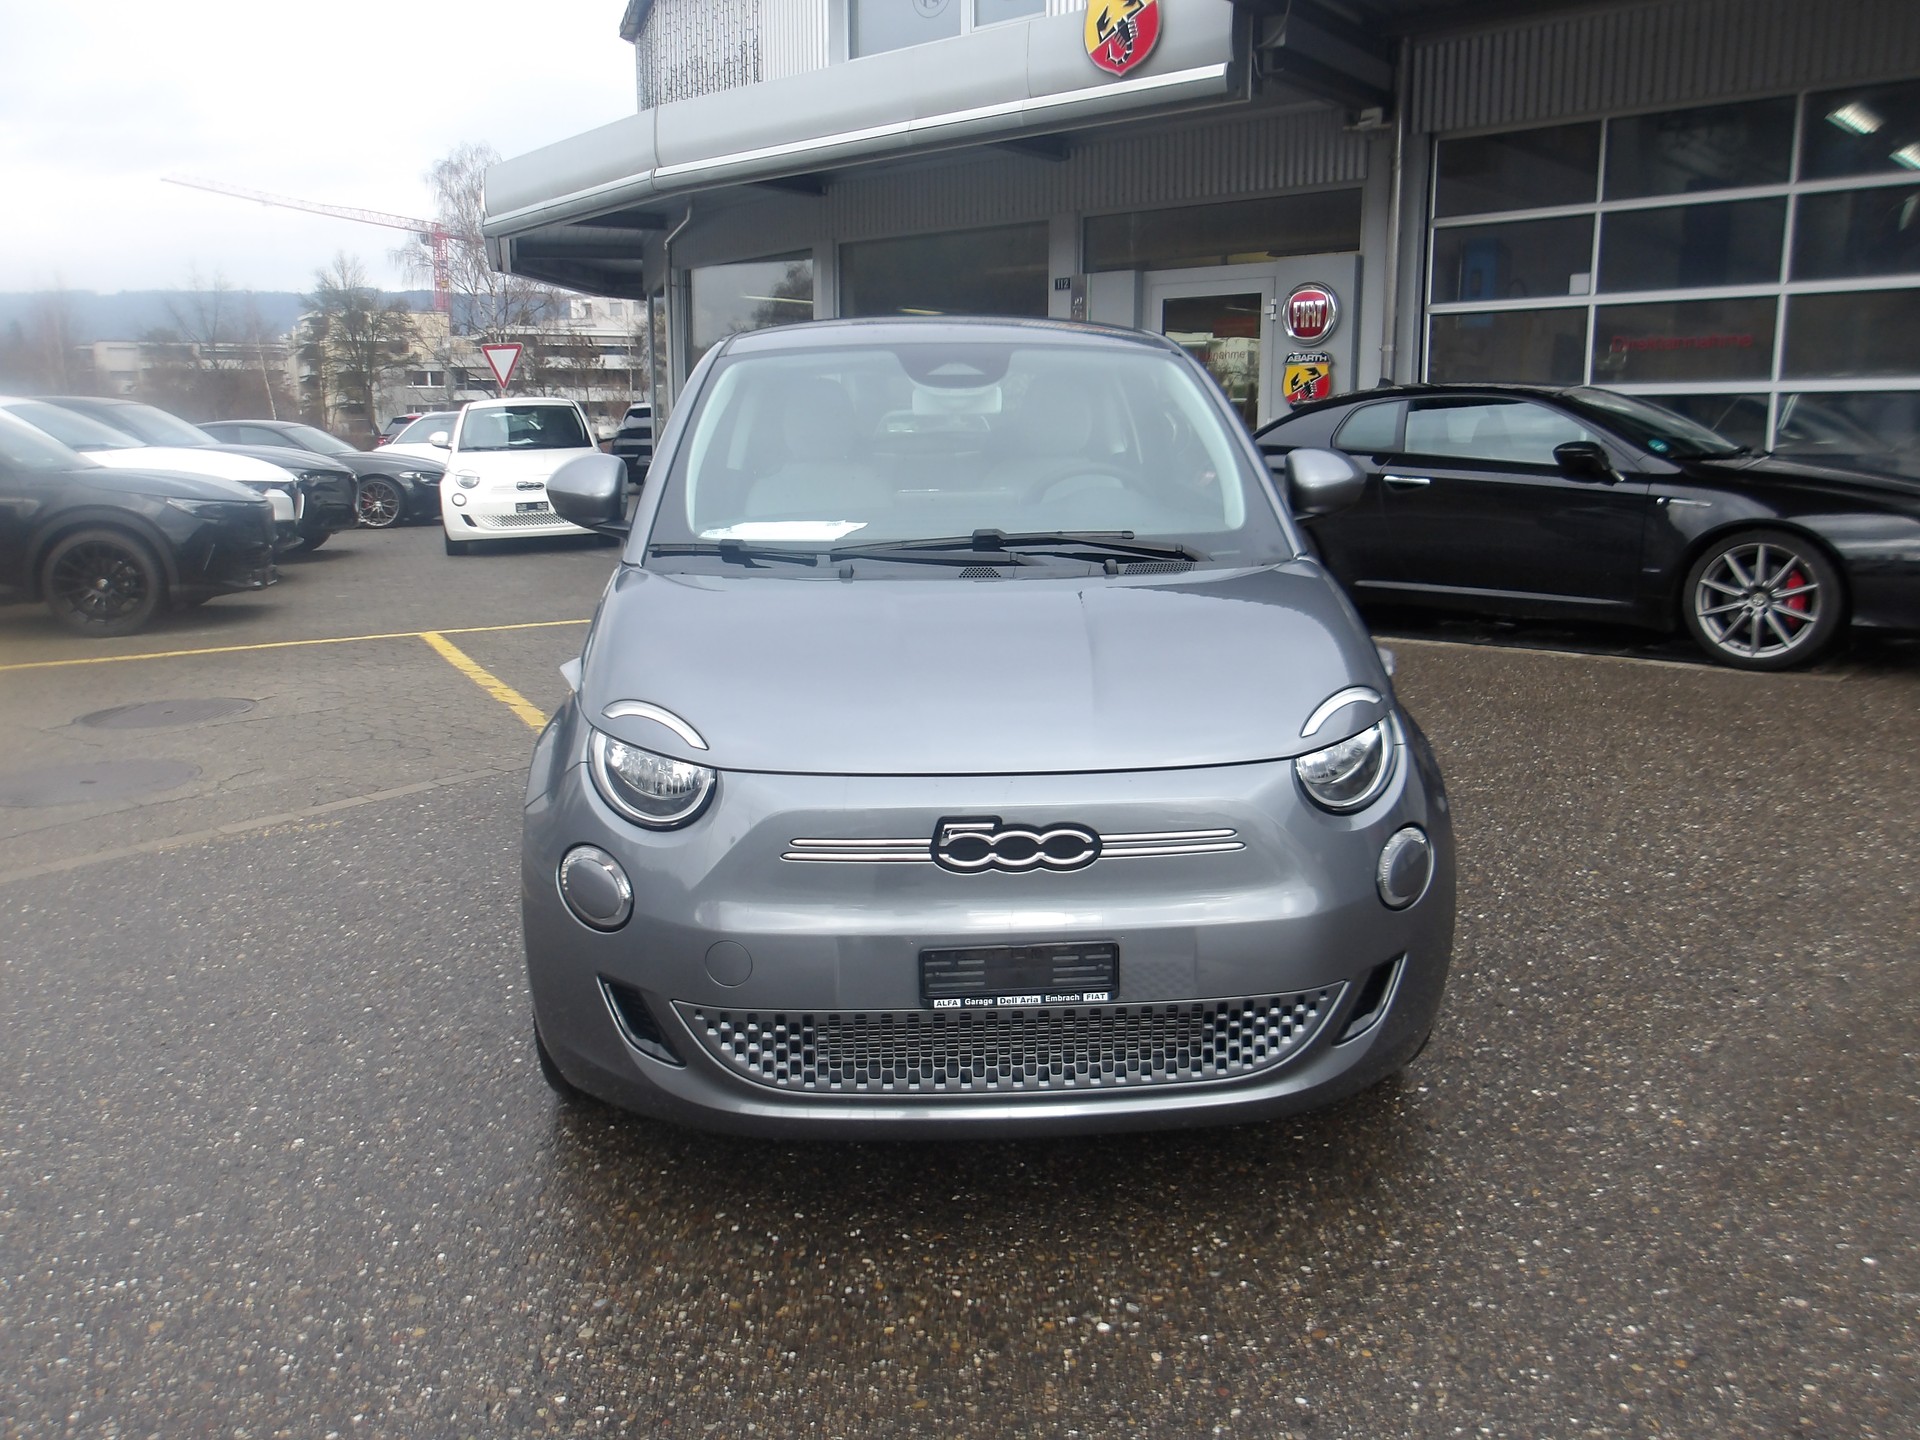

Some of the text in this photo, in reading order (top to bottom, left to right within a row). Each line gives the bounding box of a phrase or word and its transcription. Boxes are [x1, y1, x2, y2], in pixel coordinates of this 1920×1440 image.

[1057, 279, 1070, 289] 112
[1293, 300, 1326, 328] FIAT
[1287, 353, 1328, 362] ABARTH
[935, 818, 1098, 870] 500
[936, 999, 958, 1007] ALFA
[964, 998, 993, 1006] Garage
[1045, 993, 1080, 1002] Embrach
